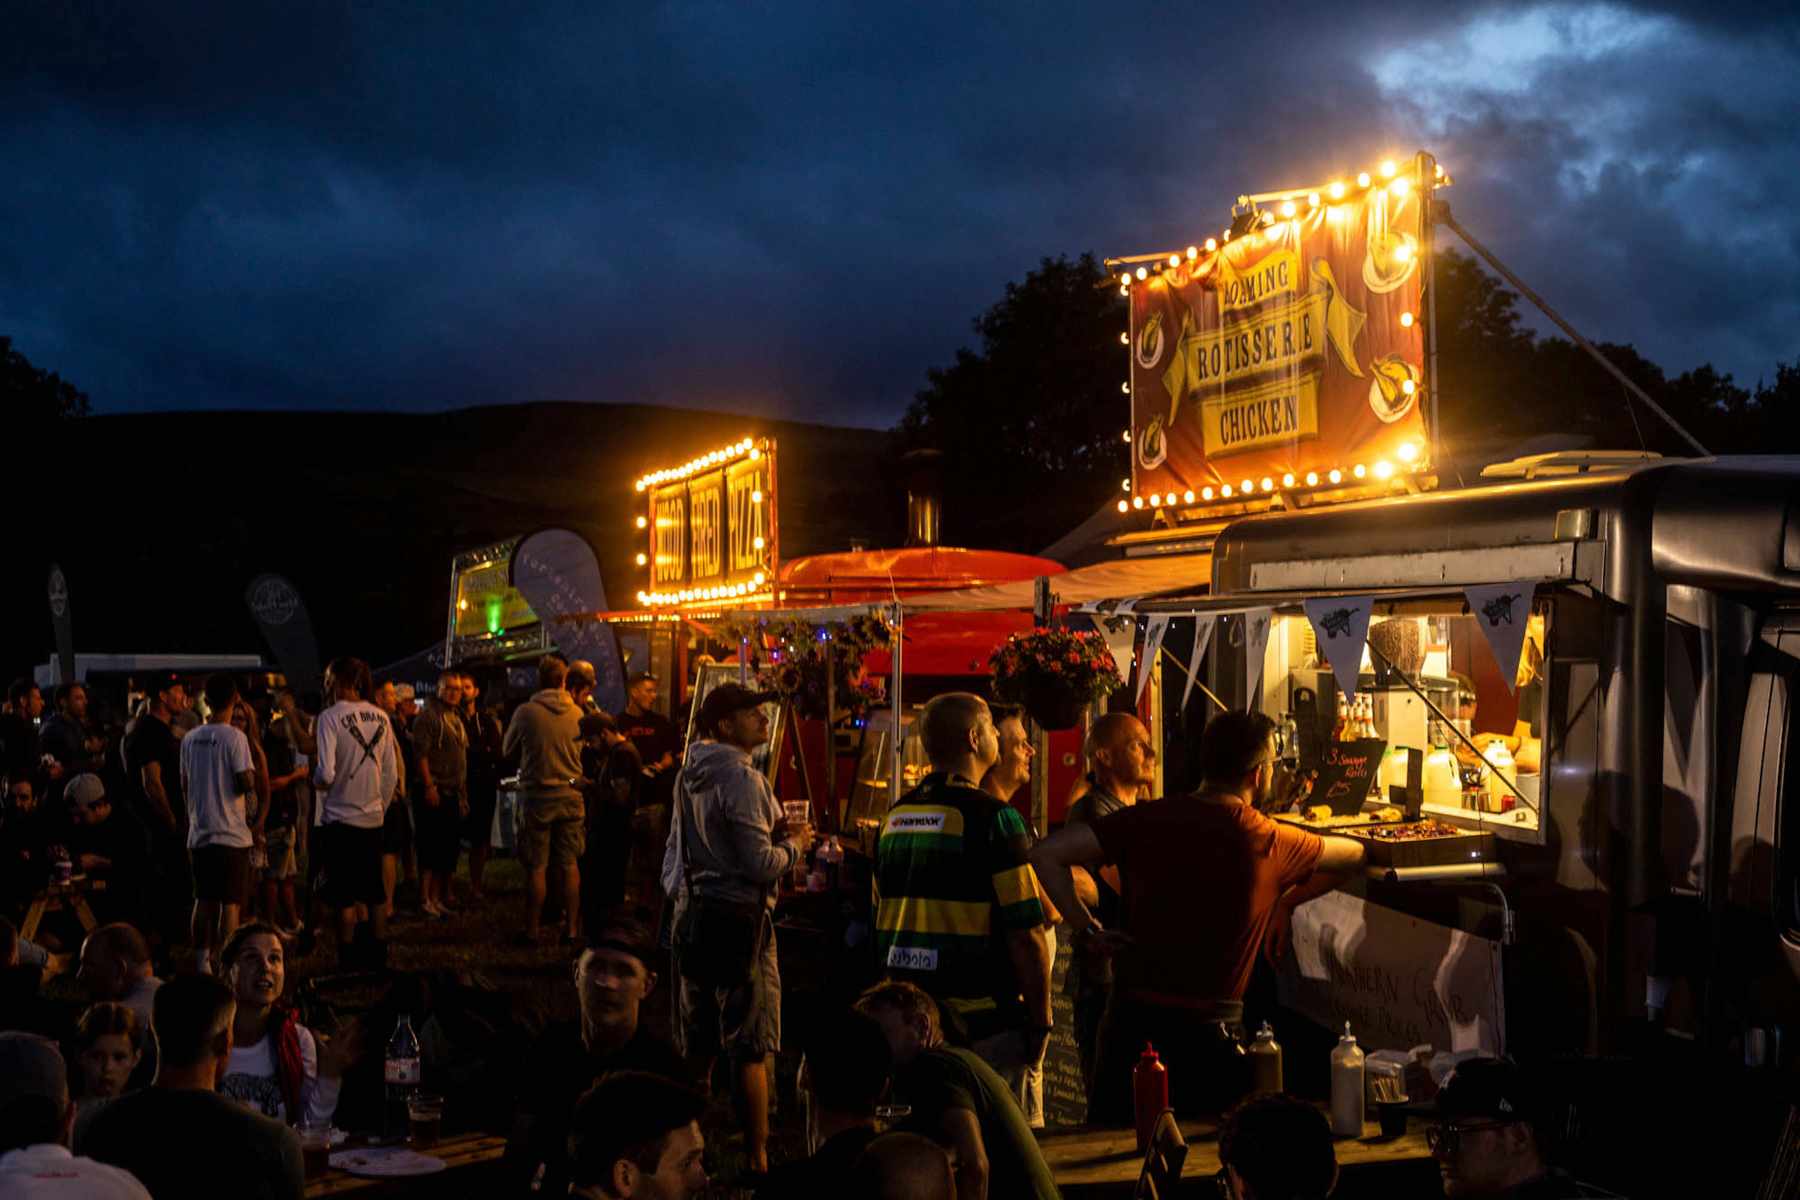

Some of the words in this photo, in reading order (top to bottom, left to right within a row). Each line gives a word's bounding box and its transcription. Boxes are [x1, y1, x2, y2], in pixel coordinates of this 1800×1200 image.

[1197, 312, 1312, 380] ROTISSERIE
[1219, 395, 1298, 446] CHICKEN
[656, 496, 685, 583] WOOD
[691, 485, 721, 580] FIRED
[727, 469, 764, 573] PIZZA
